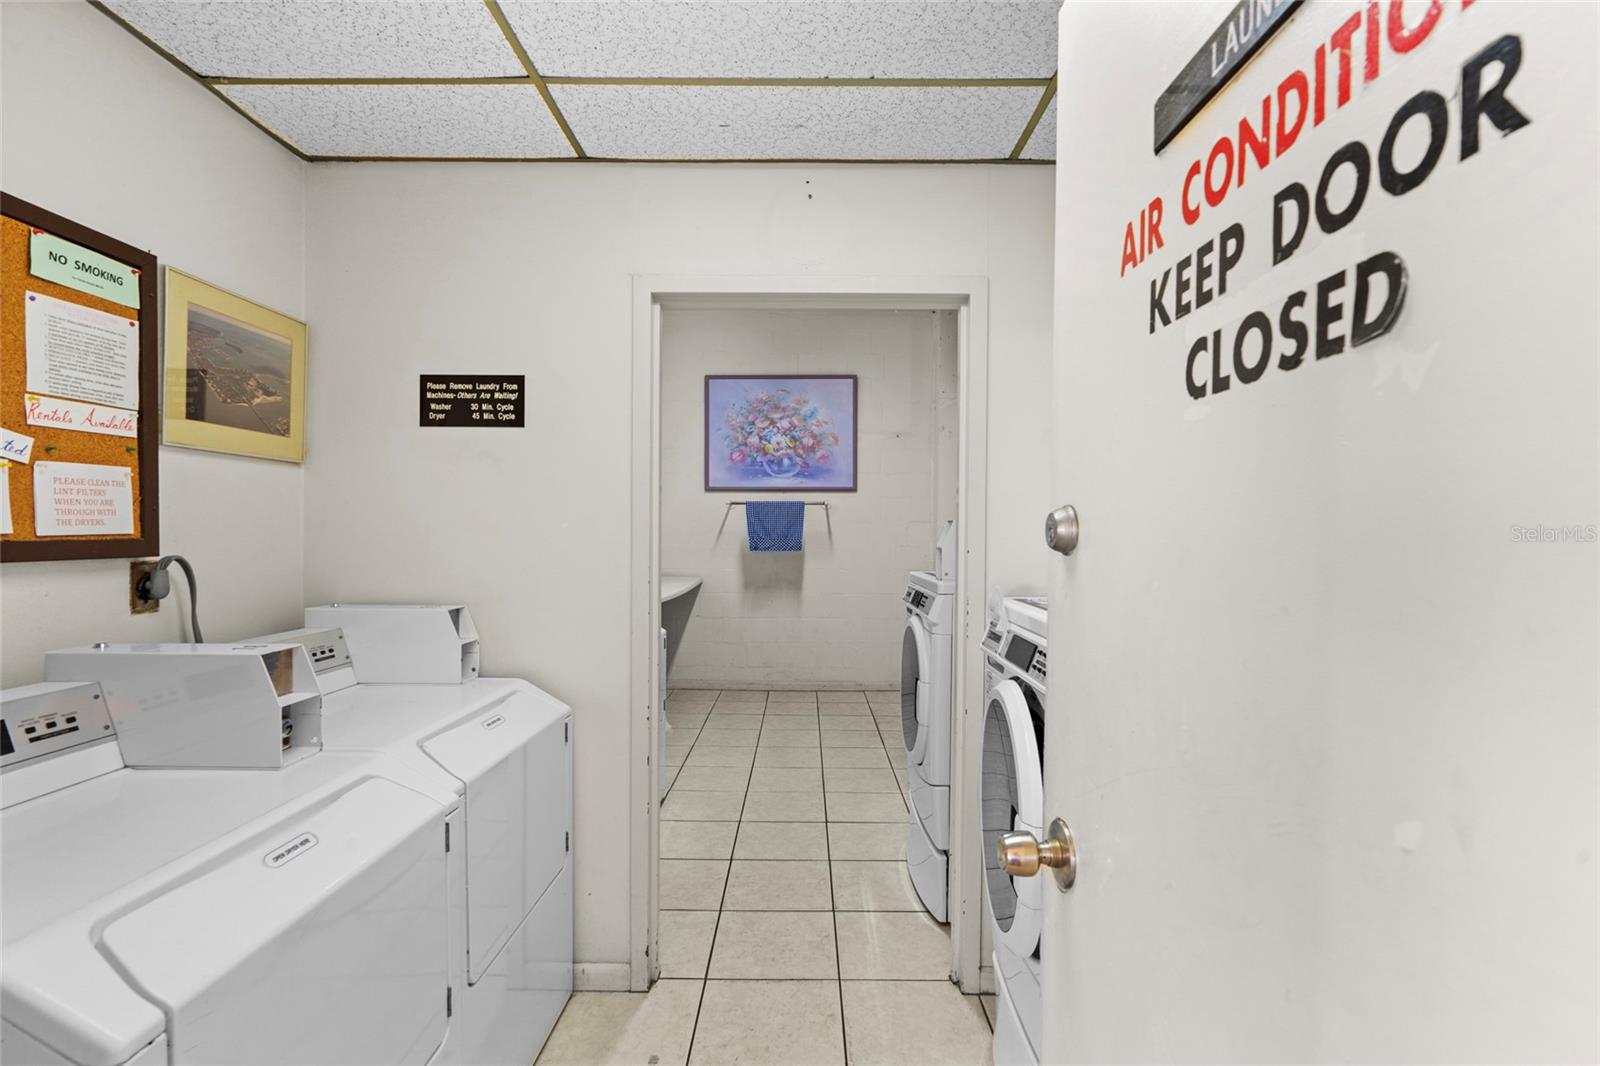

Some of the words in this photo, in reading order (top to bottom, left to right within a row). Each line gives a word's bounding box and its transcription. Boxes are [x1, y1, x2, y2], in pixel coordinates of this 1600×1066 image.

[1211, 0, 1281, 78] LAUN
[1120, 196, 1165, 278] AIR
[1182, 0, 1477, 226] CONDITIO
[1149, 222, 1244, 334] KEEP
[1272, 34, 1532, 265] DOOR
[48, 250, 68, 266] NO
[74, 260, 124, 286] SMOKING
[1186, 250, 1410, 400] CLOSED
[476, 382, 500, 391] Laundry
[494, 392, 518, 400] Waiting!
[496, 403, 514, 412] Cycle
[28, 402, 72, 423] Rentals
[429, 412, 446, 421] Dryer
[498, 413, 515, 421] Cycle
[53, 477, 86, 486] PLEASE
[87, 478, 110, 487] CLEAN
[111, 480, 126, 488] THE
[53, 488, 73, 496] LINT
[76, 488, 106, 496] FILTERS
[54, 498, 82, 506] WHEN
[55, 508, 96, 516] THROUGH
[56, 518, 72, 526] THE
